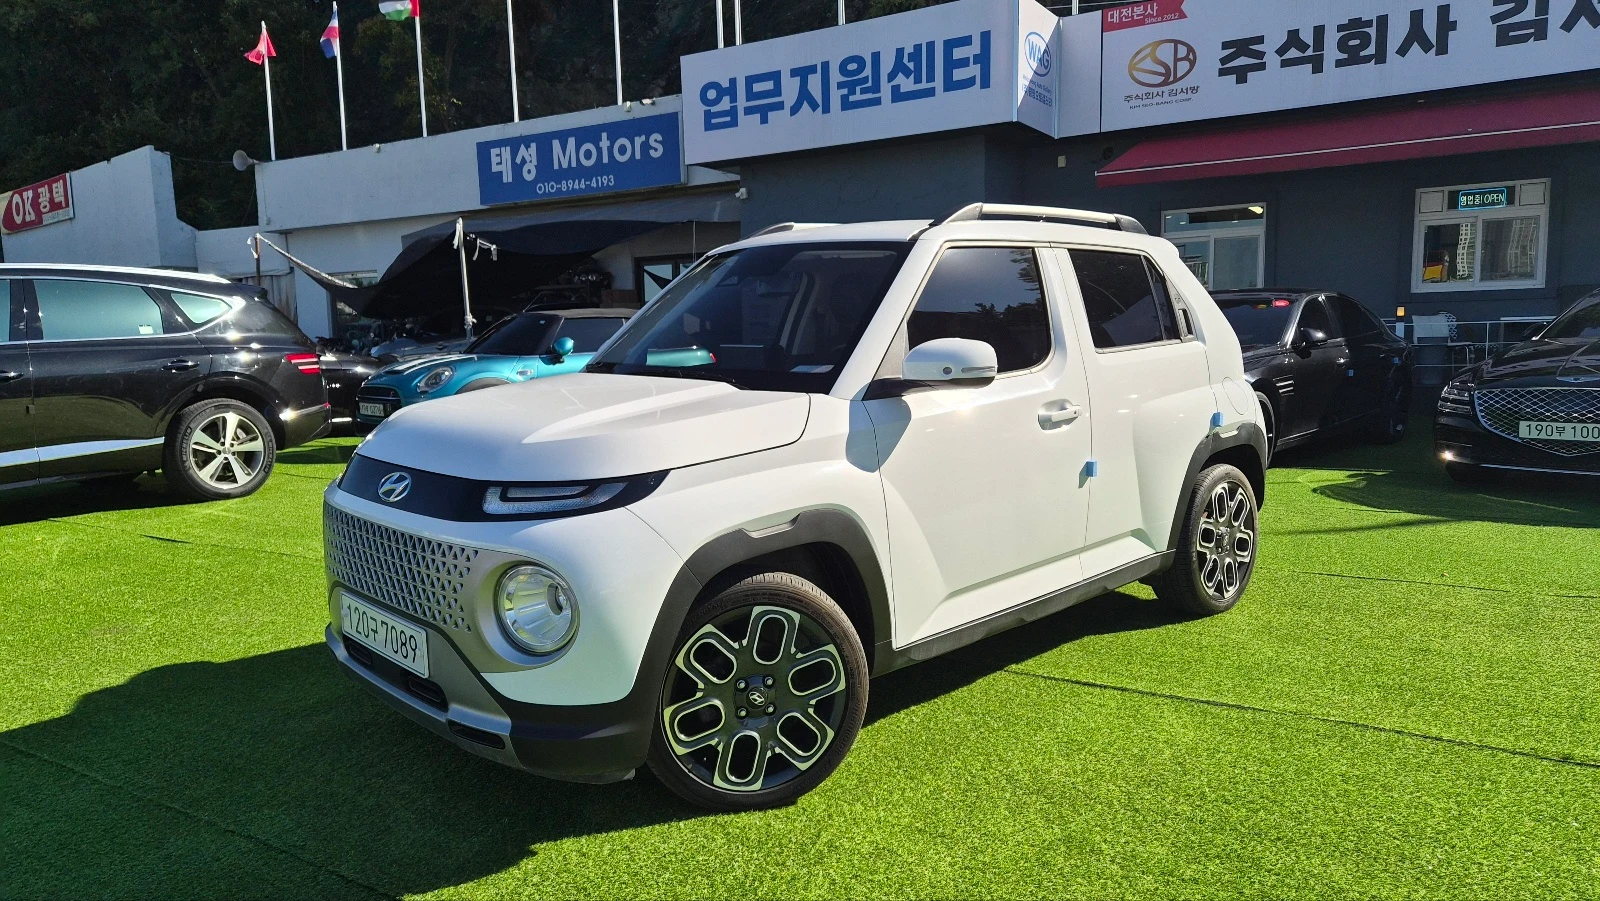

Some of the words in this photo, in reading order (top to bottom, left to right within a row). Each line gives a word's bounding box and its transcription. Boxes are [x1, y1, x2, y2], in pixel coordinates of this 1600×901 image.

[1107, 2, 1158, 23] 대전본사
[1144, 17, 1162, 25] Since
[1162, 12, 1180, 21] 2012
[1028, 38, 1050, 71] WAG
[1218, 4, 1458, 85] 주식회사
[699, 29, 992, 132] 업무지원센터
[1123, 90, 1166, 104] 주식회사
[490, 142, 538, 184] 태성
[552, 132, 664, 170] Motors
[536, 174, 615, 195] 010-8944-4193
[12, 190, 36, 225] OK
[38, 179, 66, 213] 광택
[1483, 192, 1505, 204] OPEN
[1525, 423, 1566, 437] 190부
